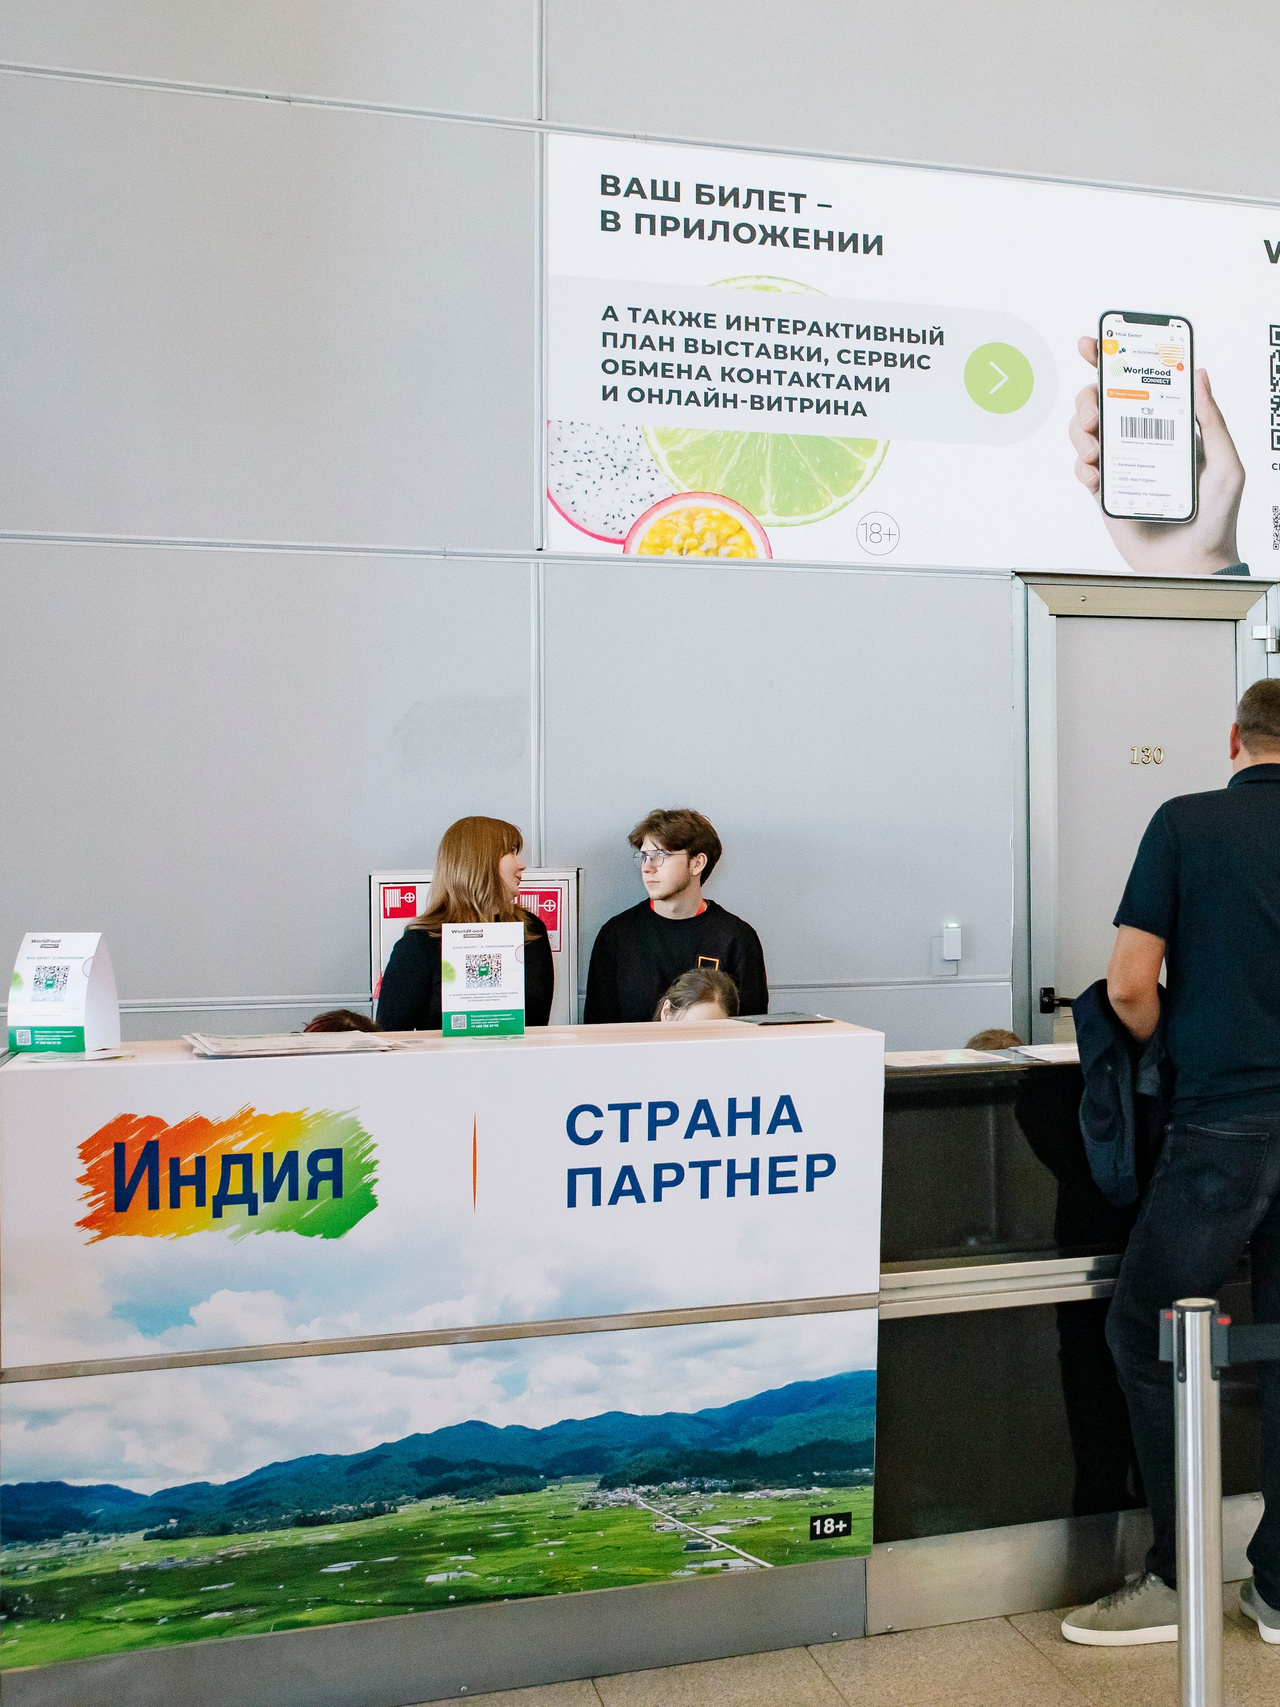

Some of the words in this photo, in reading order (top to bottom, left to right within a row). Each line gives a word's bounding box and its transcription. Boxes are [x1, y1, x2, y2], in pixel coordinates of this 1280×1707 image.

[600, 174, 680, 203] ВАШ
[696, 183, 807, 214] БИЛЕТ
[601, 210, 621, 232] В
[635, 213, 884, 256] ПРИЛОЖЕНИИ
[602, 305, 619, 322] А
[627, 307, 717, 330] ТАКЖЕ
[726, 315, 945, 347] ИНТЕРАКТИВНЫЙ
[602, 332, 675, 353] ПЛАН
[685, 338, 830, 366] ВЫСТАВКИ,
[837, 349, 931, 370] СЕРВИС
[601, 359, 712, 381] ОБМЕНА
[721, 367, 890, 393] КОНТАКТАМИ
[1123, 366, 1171, 376] WorldFood
[602, 386, 618, 401] И
[627, 387, 867, 417] ОНЛАЙН-ВИТРИНА
[860, 522, 897, 544] 18+
[1130, 746, 1164, 765] 130
[567, 1094, 803, 1147] СТРАНА
[112, 1140, 343, 1219] Индия
[568, 1153, 837, 1208] ПАРТНЕР
[812, 1516, 849, 1537] 18+
